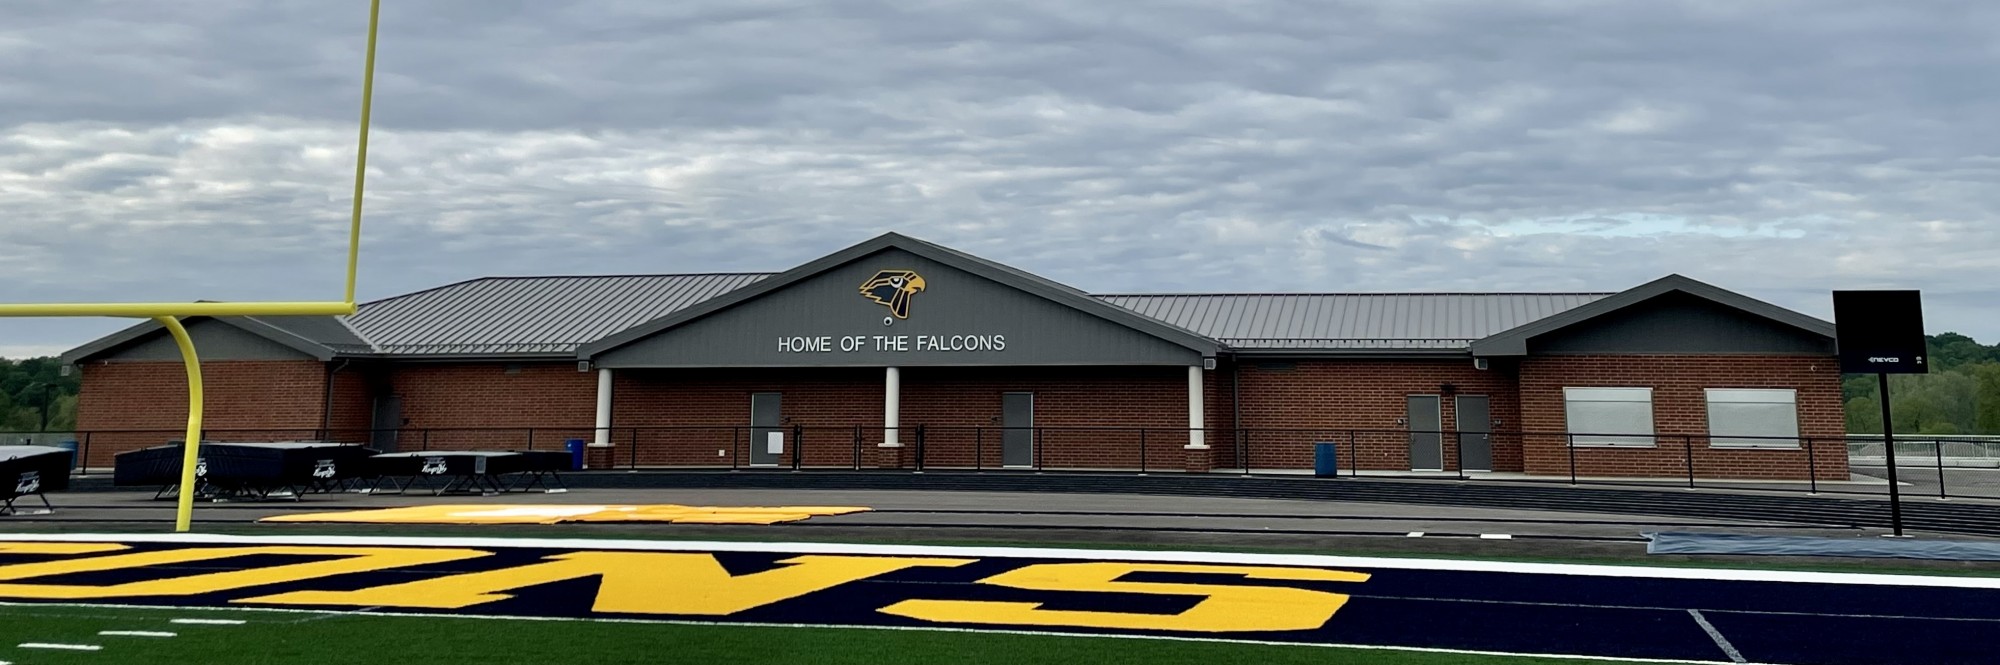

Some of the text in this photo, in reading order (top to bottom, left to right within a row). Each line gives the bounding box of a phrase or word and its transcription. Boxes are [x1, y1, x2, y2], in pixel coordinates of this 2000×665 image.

[778, 334, 1006, 352] HOME OF THE FALCONS
[0, 542, 1371, 632] ONS
